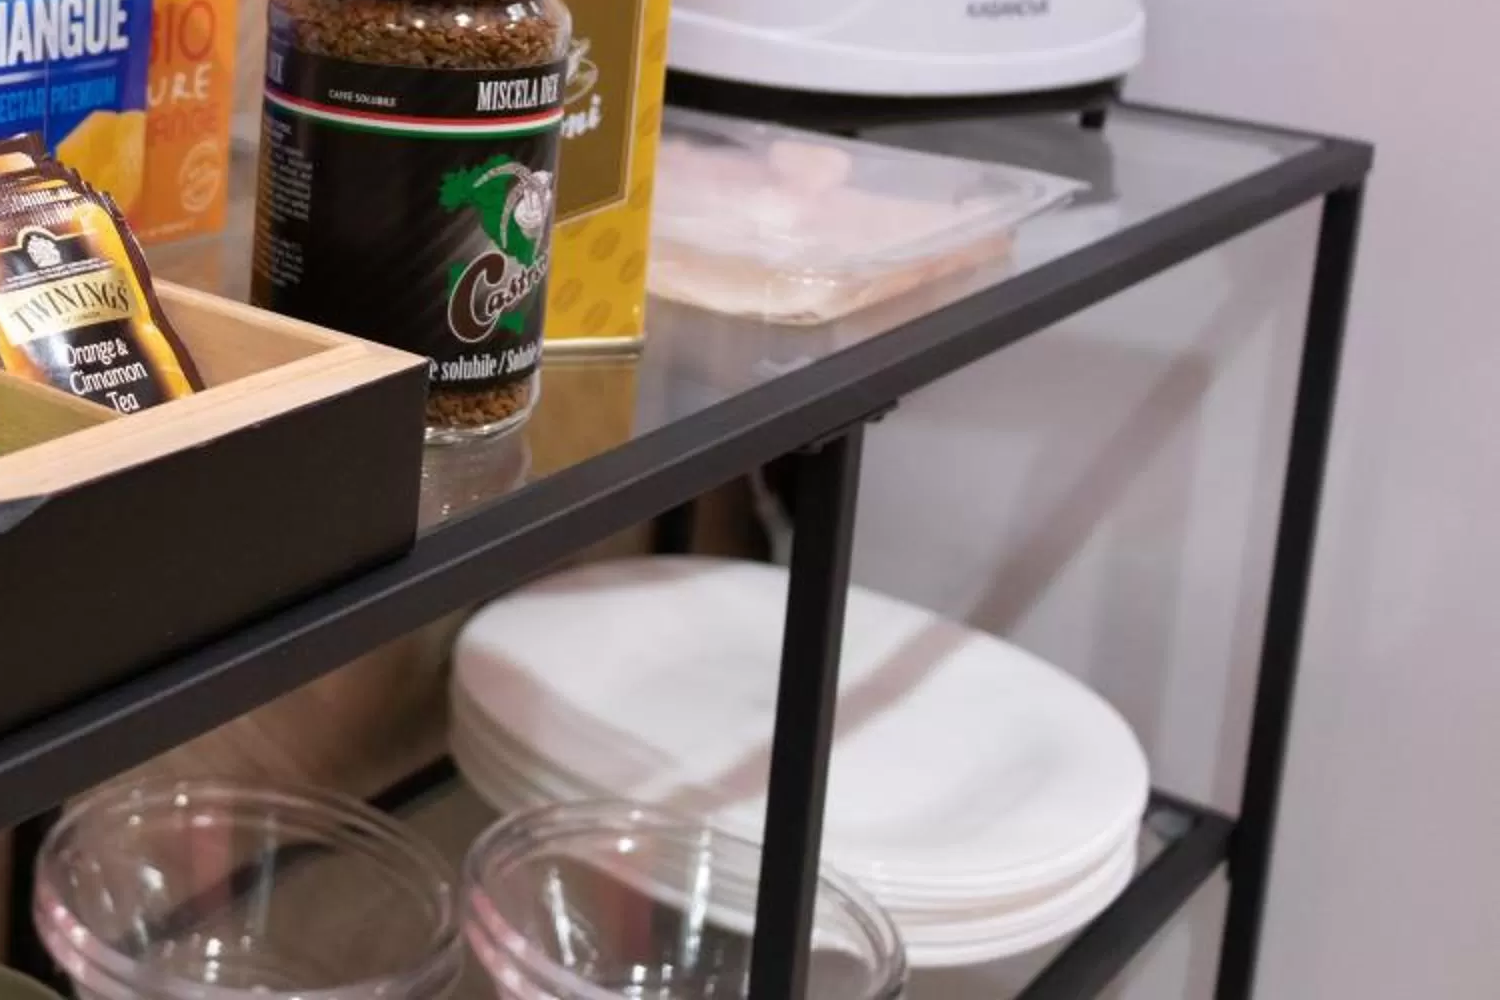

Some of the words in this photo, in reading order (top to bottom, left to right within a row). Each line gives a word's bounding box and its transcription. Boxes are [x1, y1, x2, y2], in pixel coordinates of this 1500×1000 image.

[476, 78, 538, 111] MISCELA
[9, 280, 130, 333] TWININGS
[65, 340, 117, 366] Orange
[441, 352, 497, 381] solubile
[69, 361, 149, 396] Cinnamon
[106, 391, 140, 413] Tea
